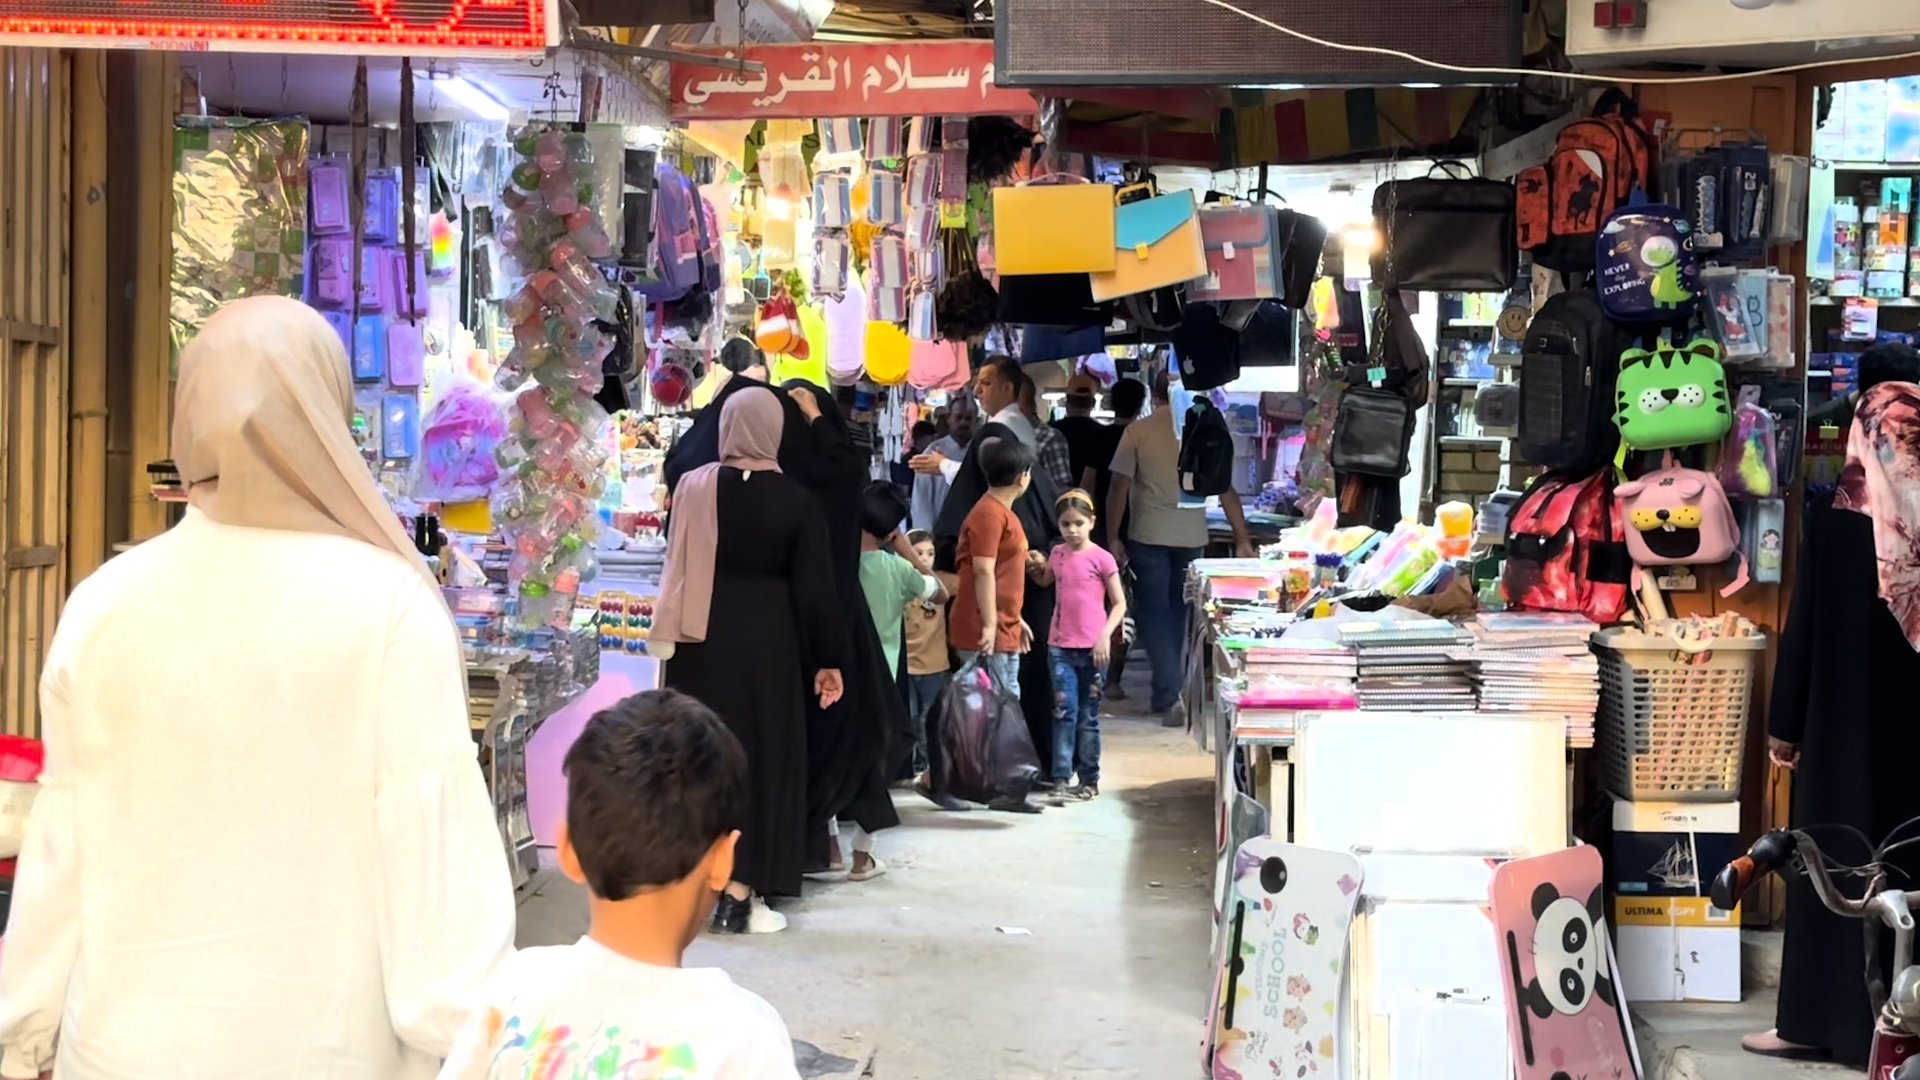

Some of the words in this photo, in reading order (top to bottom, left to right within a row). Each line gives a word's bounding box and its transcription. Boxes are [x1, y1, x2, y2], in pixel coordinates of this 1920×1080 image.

[862, 52, 970, 101] سلام
[1624, 906, 1664, 916] ULTIMA
[1263, 927, 1288, 1019] SCHOOL
